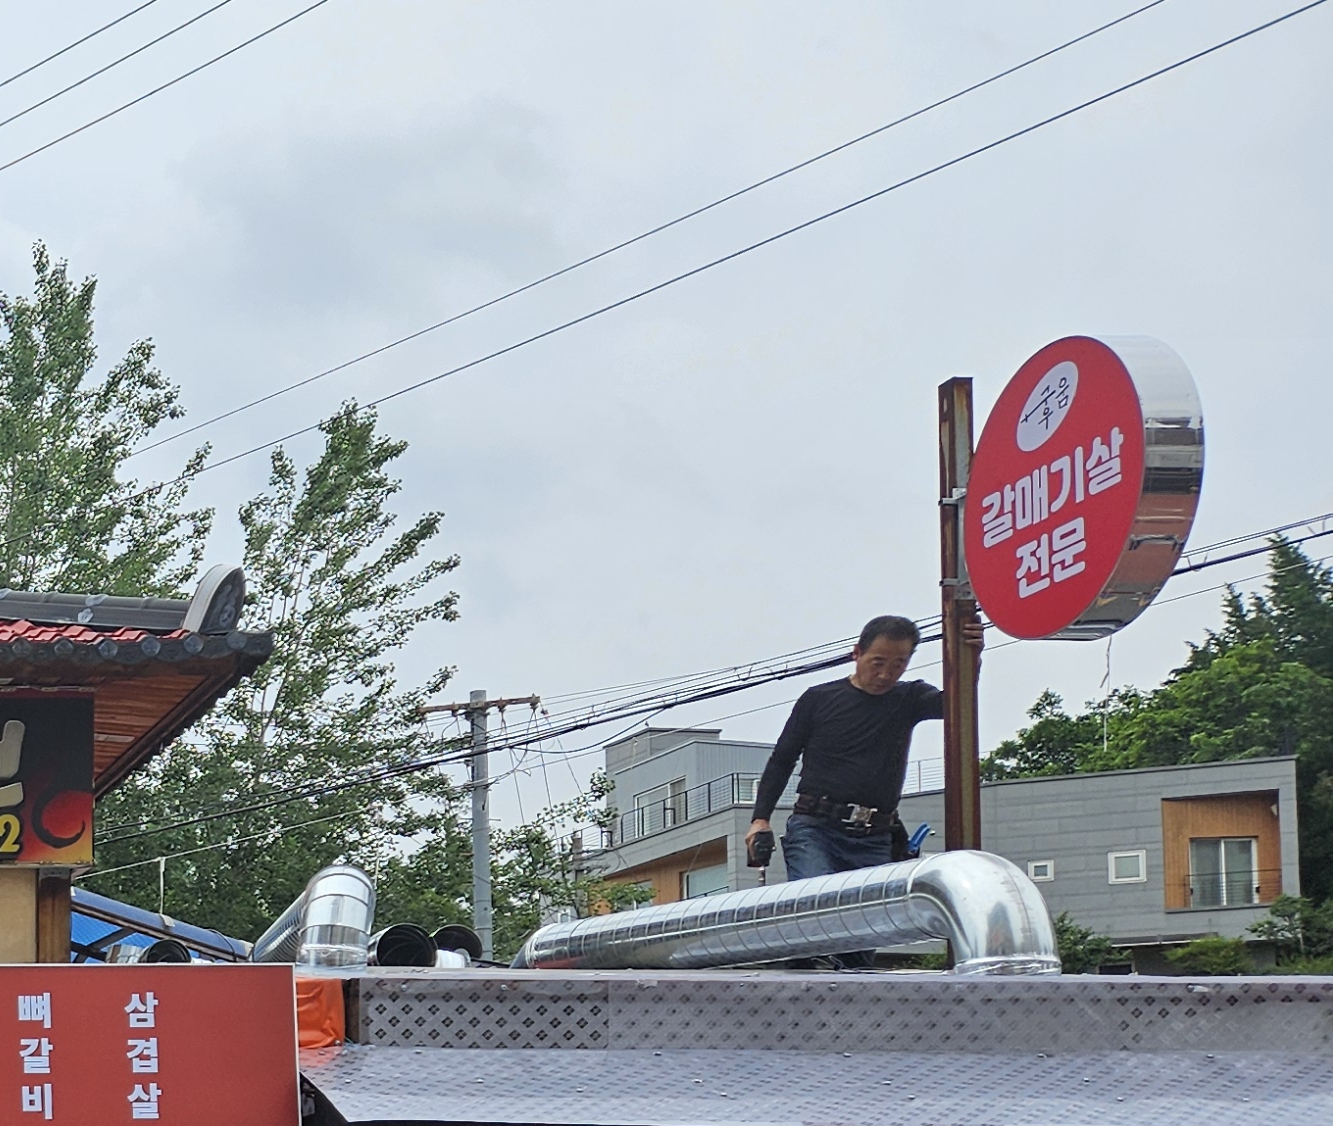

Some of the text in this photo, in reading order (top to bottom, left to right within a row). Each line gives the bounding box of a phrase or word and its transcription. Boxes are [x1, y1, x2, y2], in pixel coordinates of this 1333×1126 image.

[982, 427, 1123, 548] 갈매기살
[1016, 517, 1086, 599] 전문
[17, 992, 54, 1120] 뼈갈비
[123, 991, 162, 1120] 삼겹살
